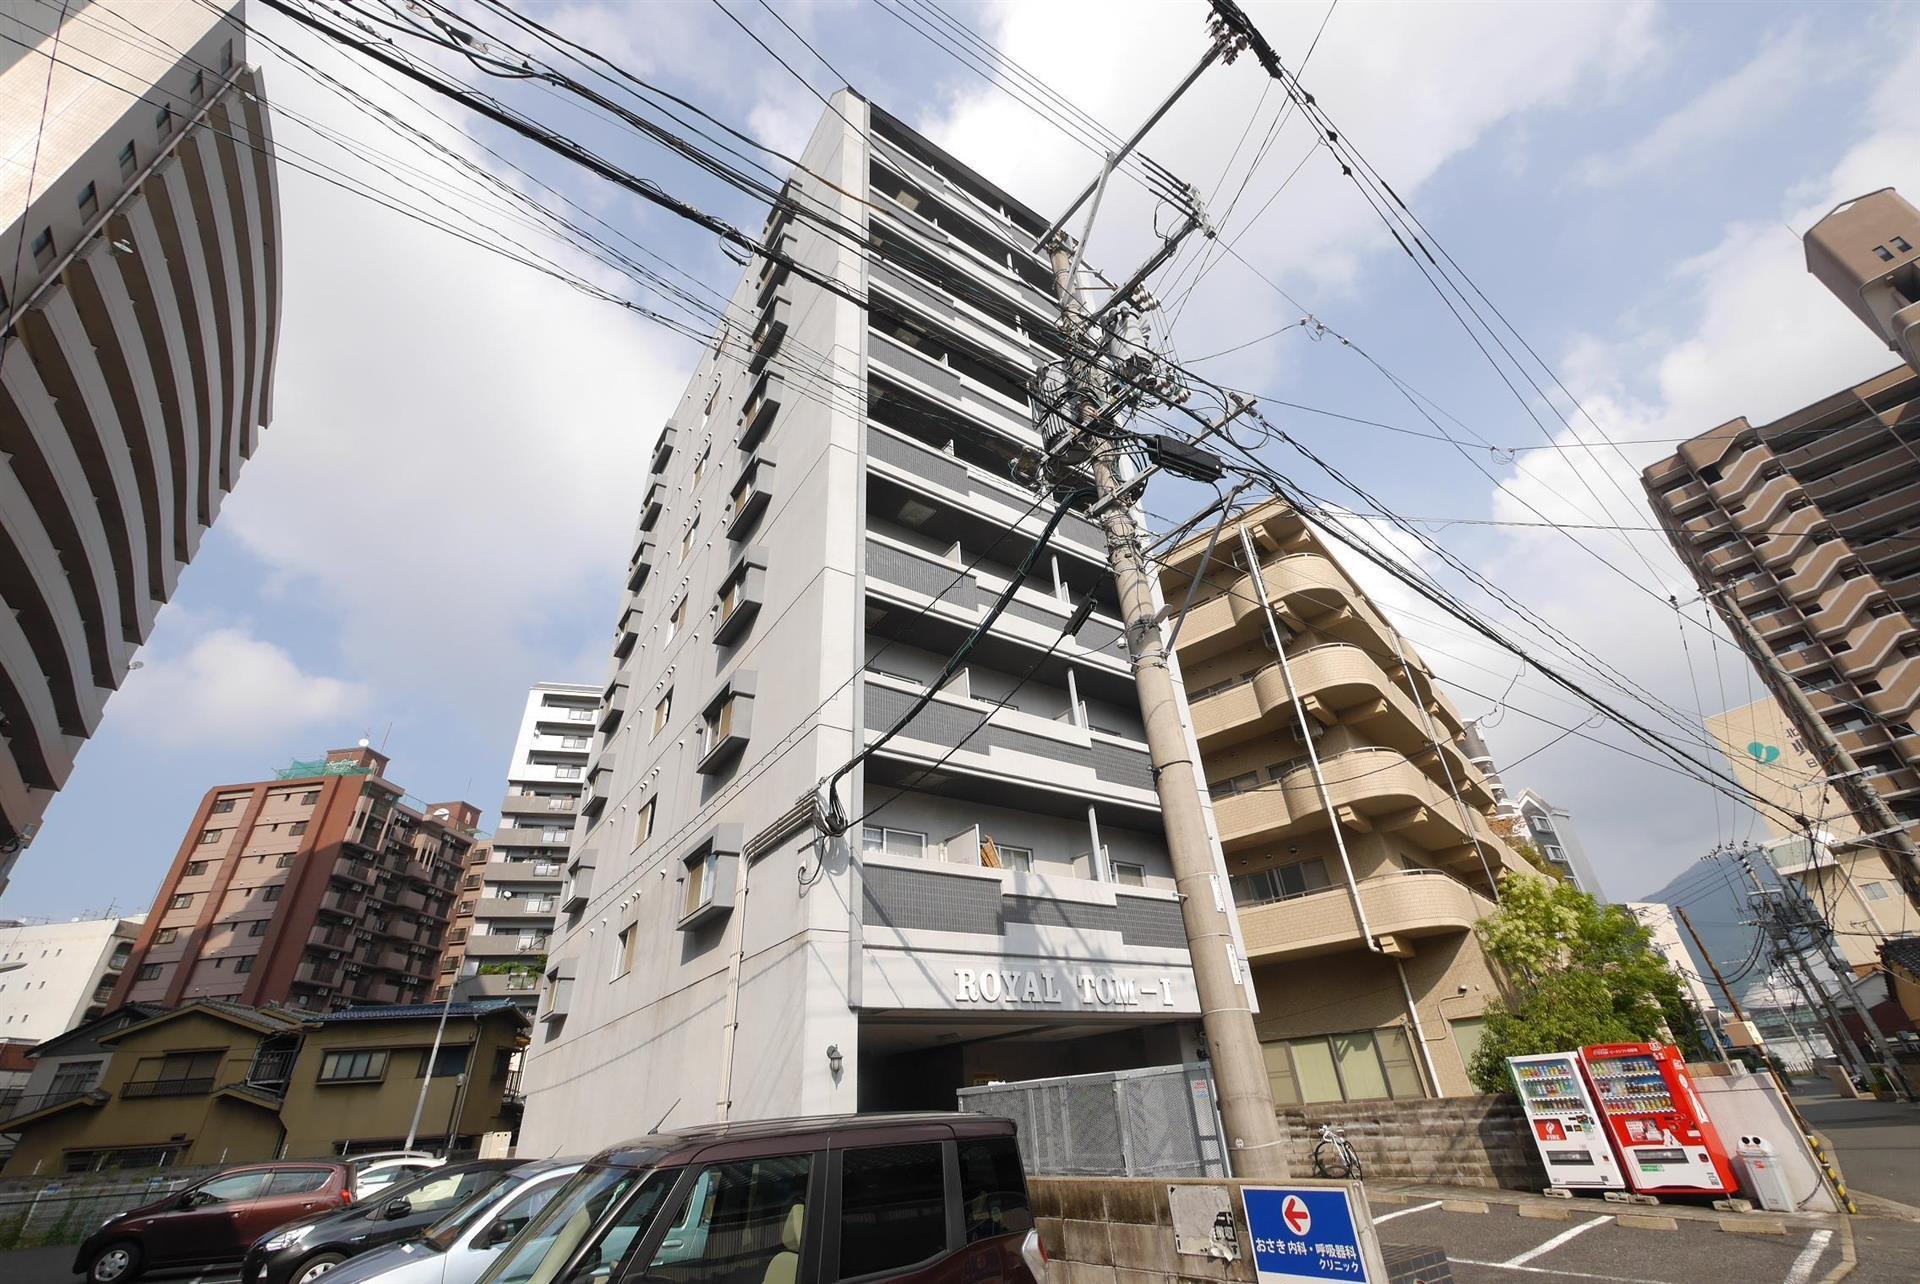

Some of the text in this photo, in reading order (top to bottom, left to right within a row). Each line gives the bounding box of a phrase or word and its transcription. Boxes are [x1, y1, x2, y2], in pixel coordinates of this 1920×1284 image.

[954, 968, 1061, 1003] ROYAL
[1319, 1258, 1359, 1273] クリニック
